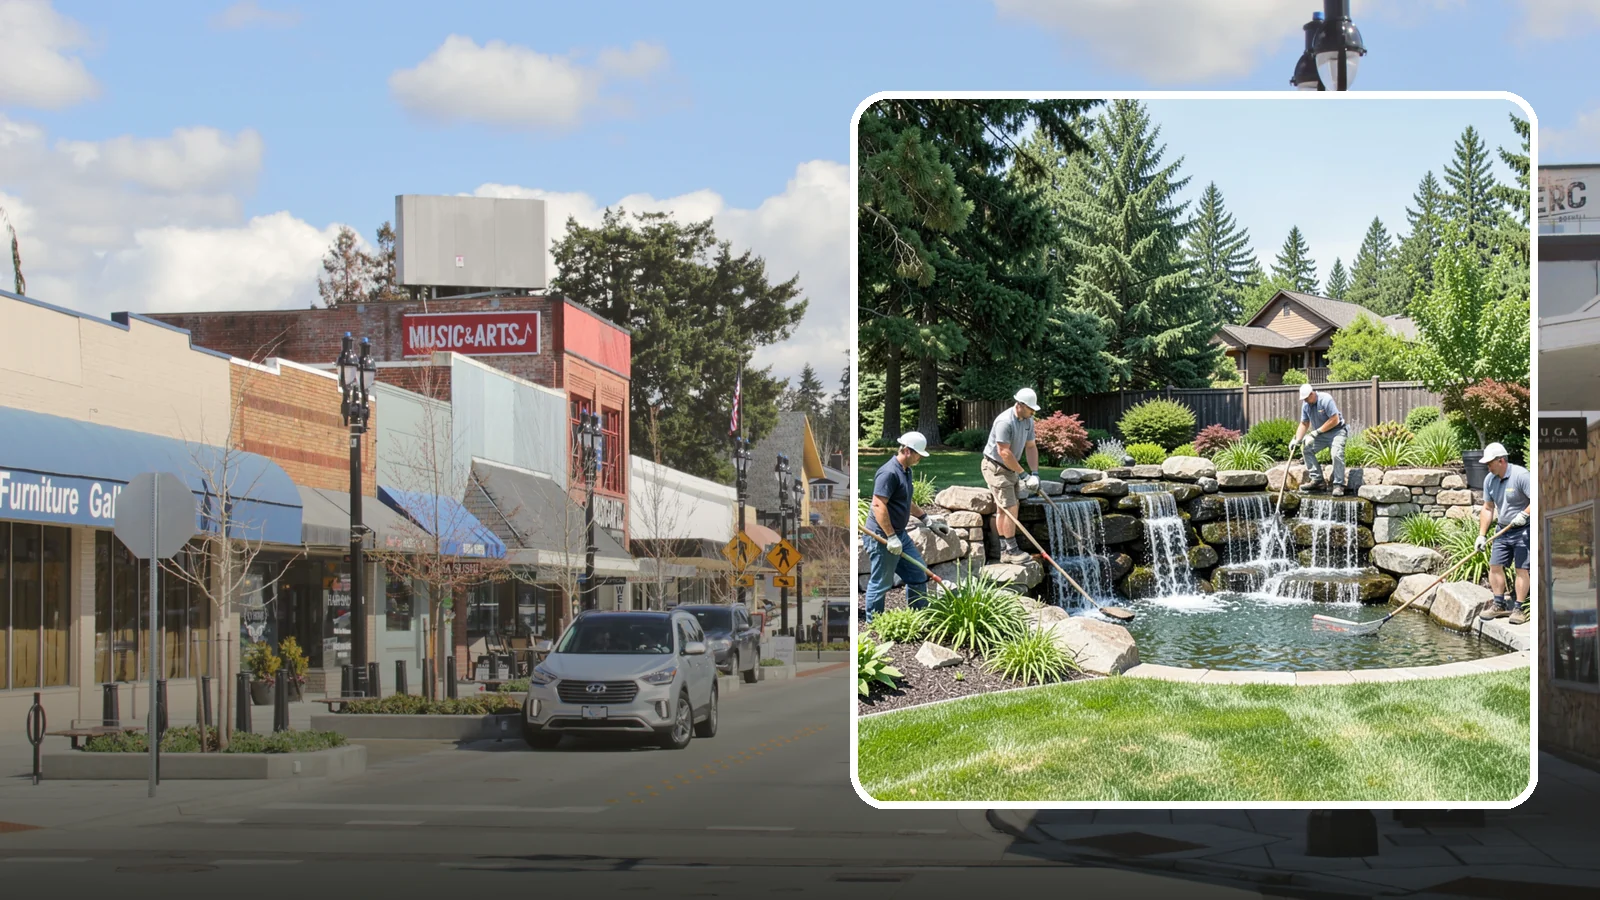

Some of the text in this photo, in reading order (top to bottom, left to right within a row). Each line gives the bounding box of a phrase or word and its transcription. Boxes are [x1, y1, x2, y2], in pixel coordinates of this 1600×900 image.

[0, 471, 122, 519] Furniture Gal
[453, 563, 479, 573] SUSHI
